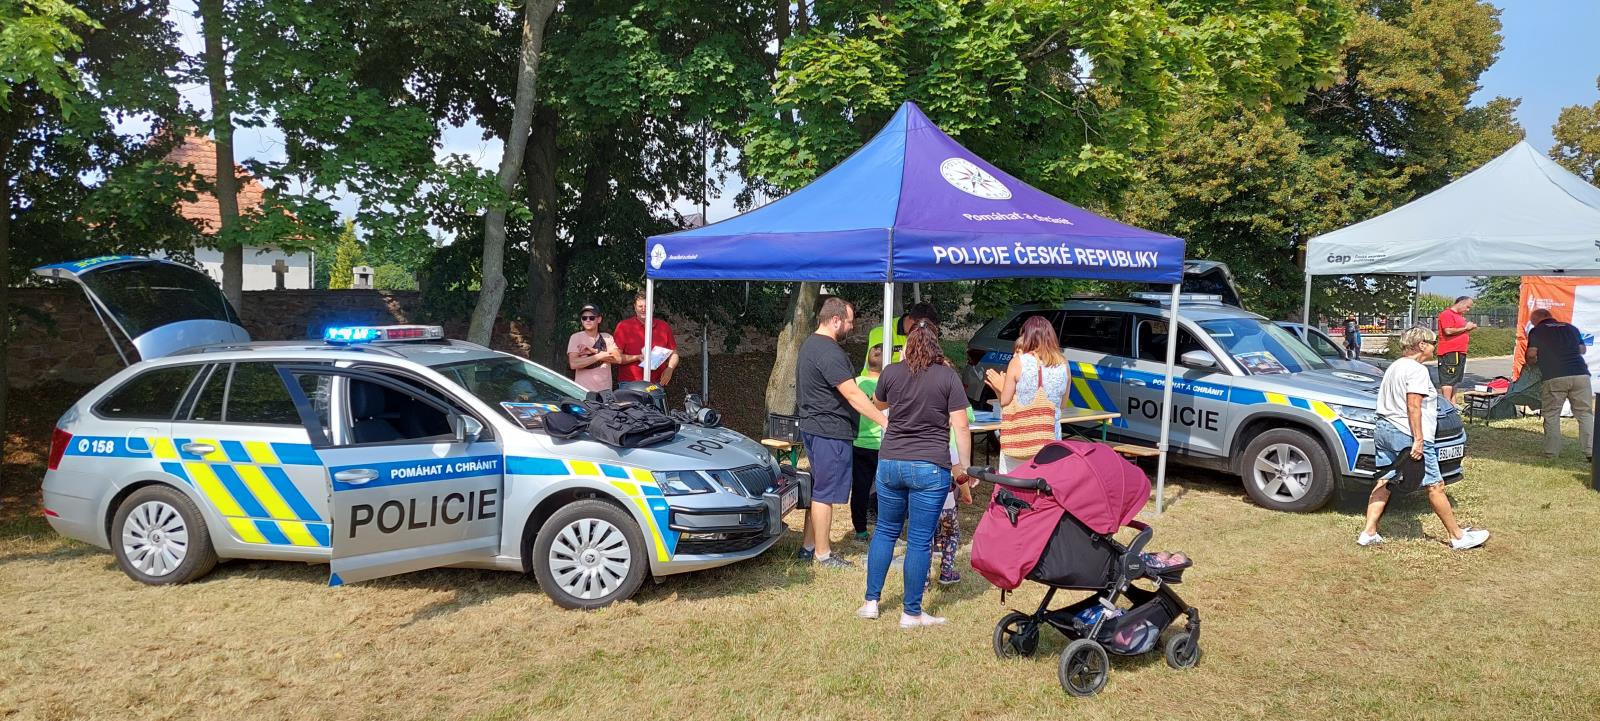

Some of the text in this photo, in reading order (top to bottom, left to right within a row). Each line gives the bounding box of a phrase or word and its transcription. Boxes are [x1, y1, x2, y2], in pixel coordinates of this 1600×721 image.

[932, 242, 1159, 268] POLICIE ČESKÉ REPUBLIKY
[1327, 253, 1351, 265] čap
[1192, 384, 1225, 396] CHRÁNIT
[92, 440, 115, 454] 158
[391, 459, 498, 480] POMÁHAT A CHRÁNIT
[349, 488, 498, 539] POLICIE
